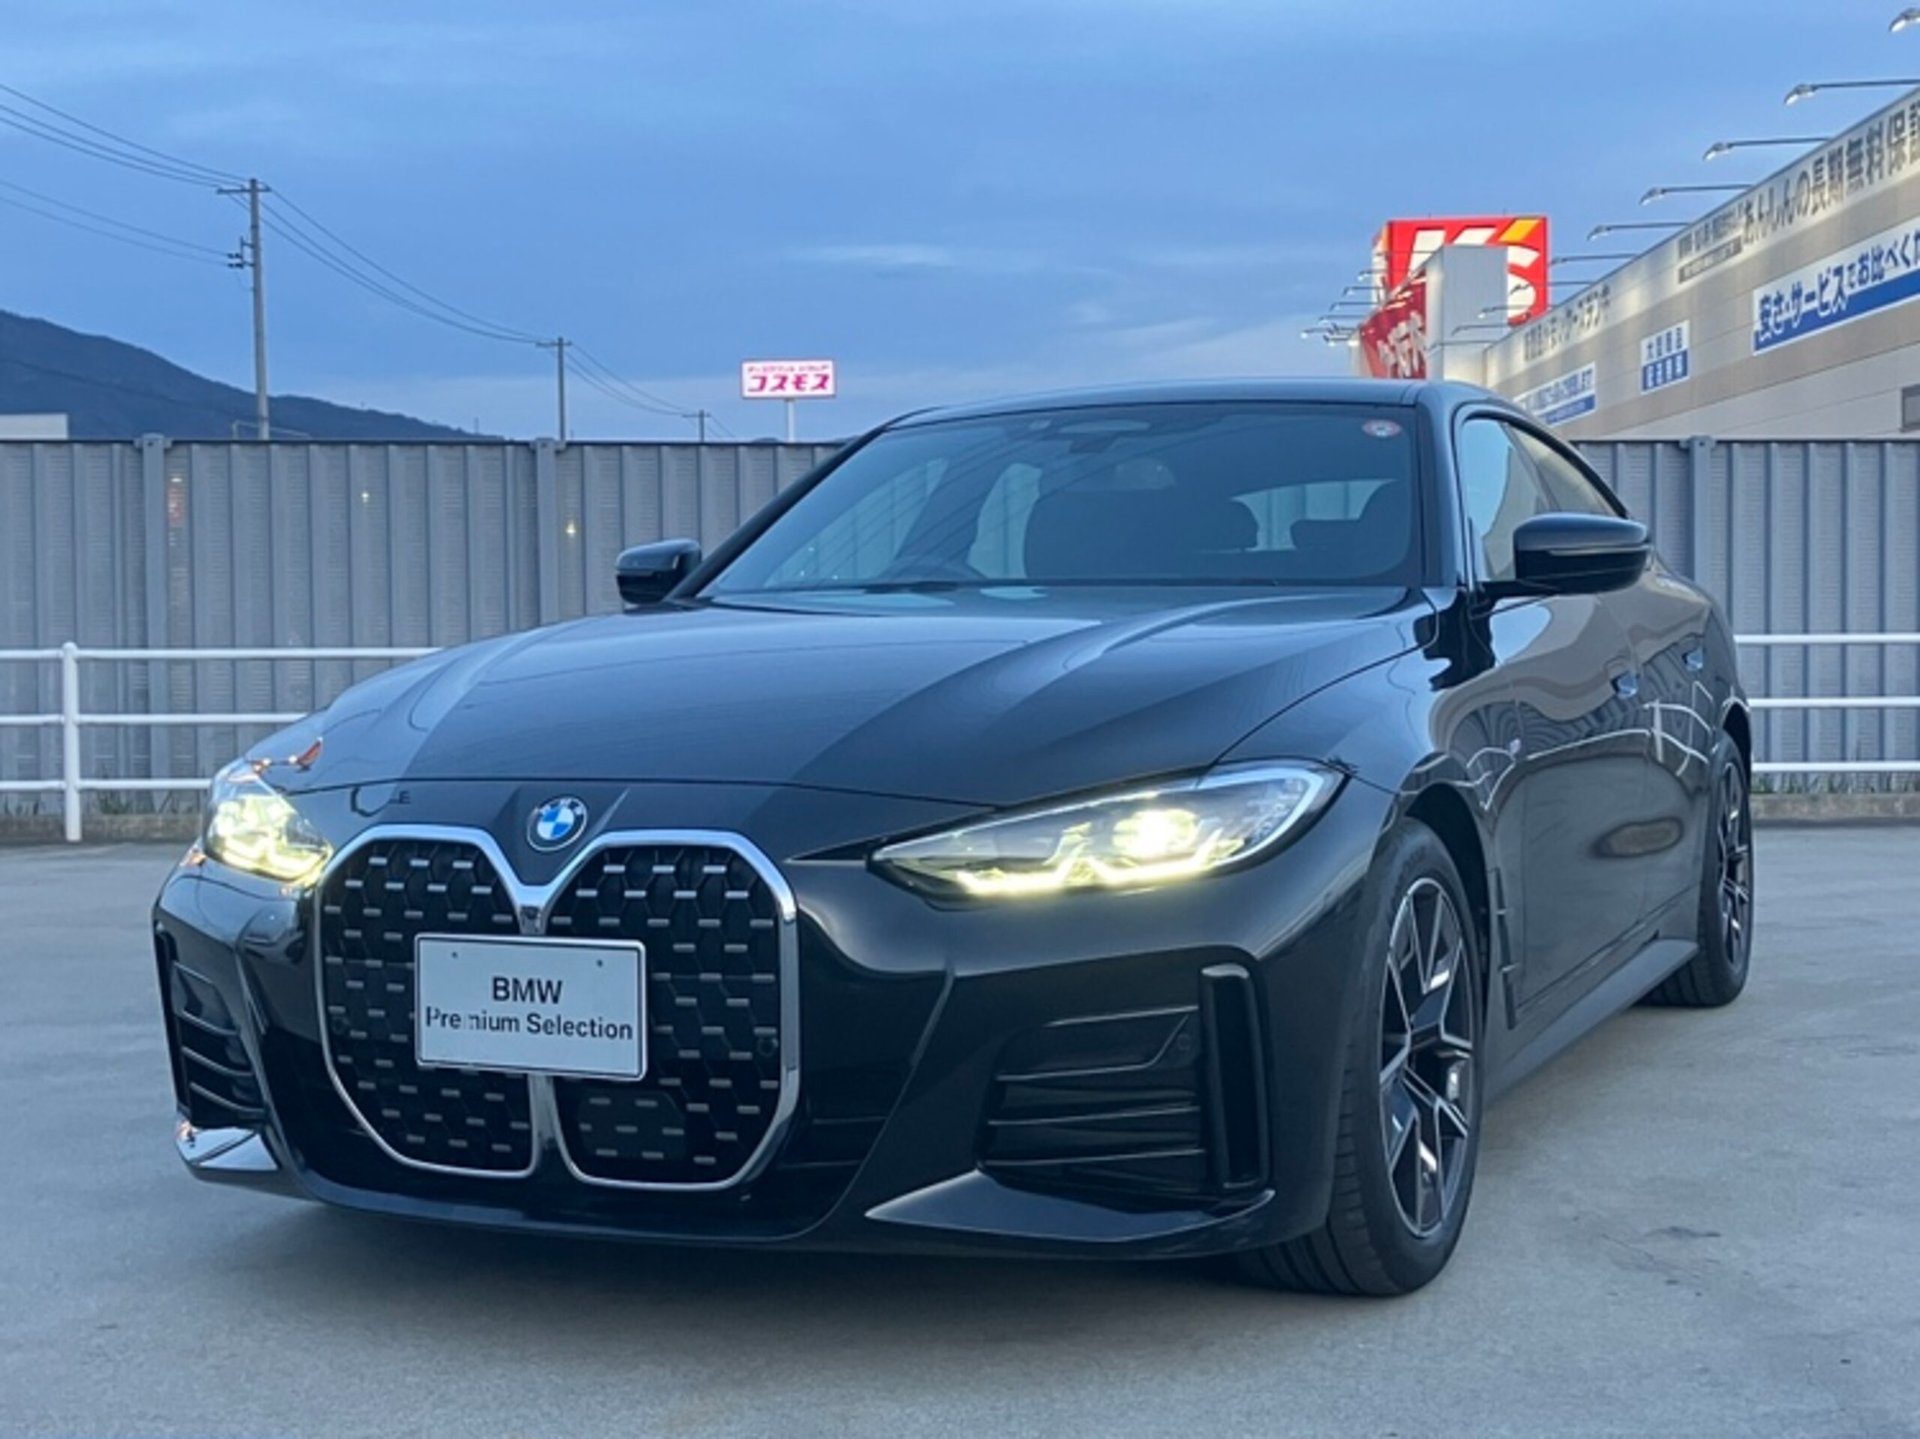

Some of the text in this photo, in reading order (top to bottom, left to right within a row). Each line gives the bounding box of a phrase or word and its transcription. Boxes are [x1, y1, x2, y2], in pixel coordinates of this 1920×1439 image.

[747, 373, 829, 392] コスモス
[492, 976, 563, 1004] BMW
[426, 1006, 633, 1040] Premium Selection
